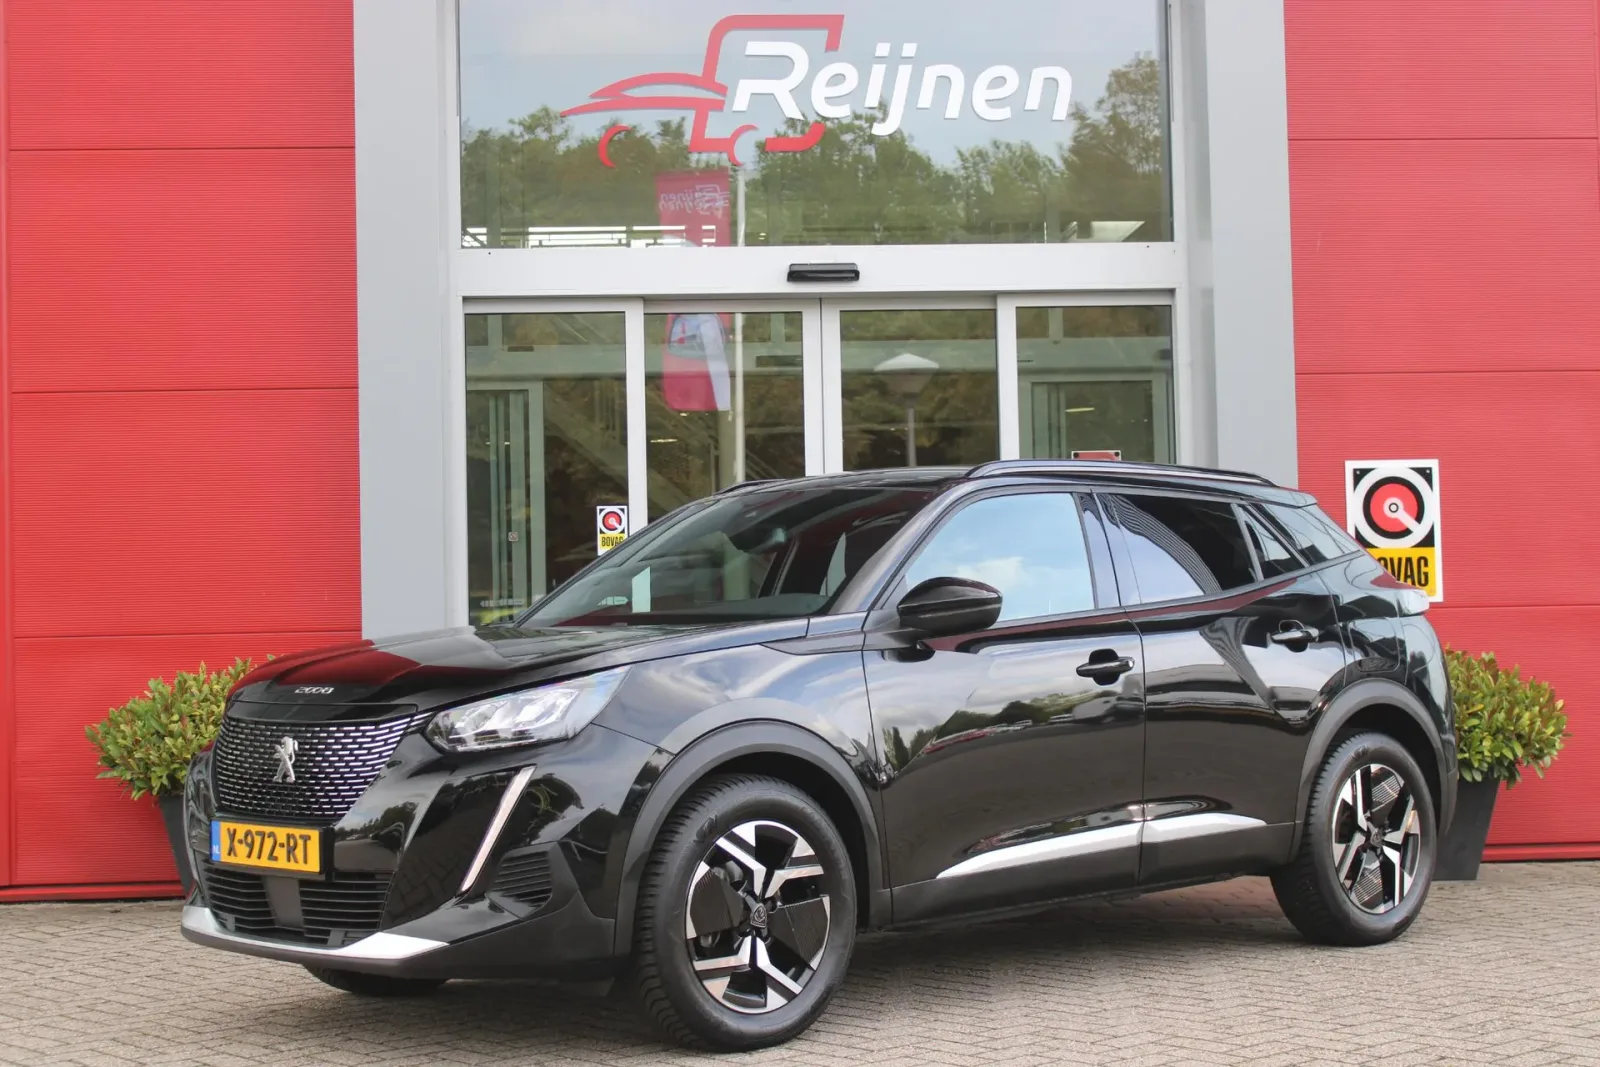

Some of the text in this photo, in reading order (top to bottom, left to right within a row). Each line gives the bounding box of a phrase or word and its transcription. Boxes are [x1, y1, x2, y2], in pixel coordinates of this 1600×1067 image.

[732, 41, 1073, 136] Reijnen
[1377, 556, 1429, 587] VAG
[294, 686, 334, 694] 2008
[227, 828, 311, 864] X-972-RT
